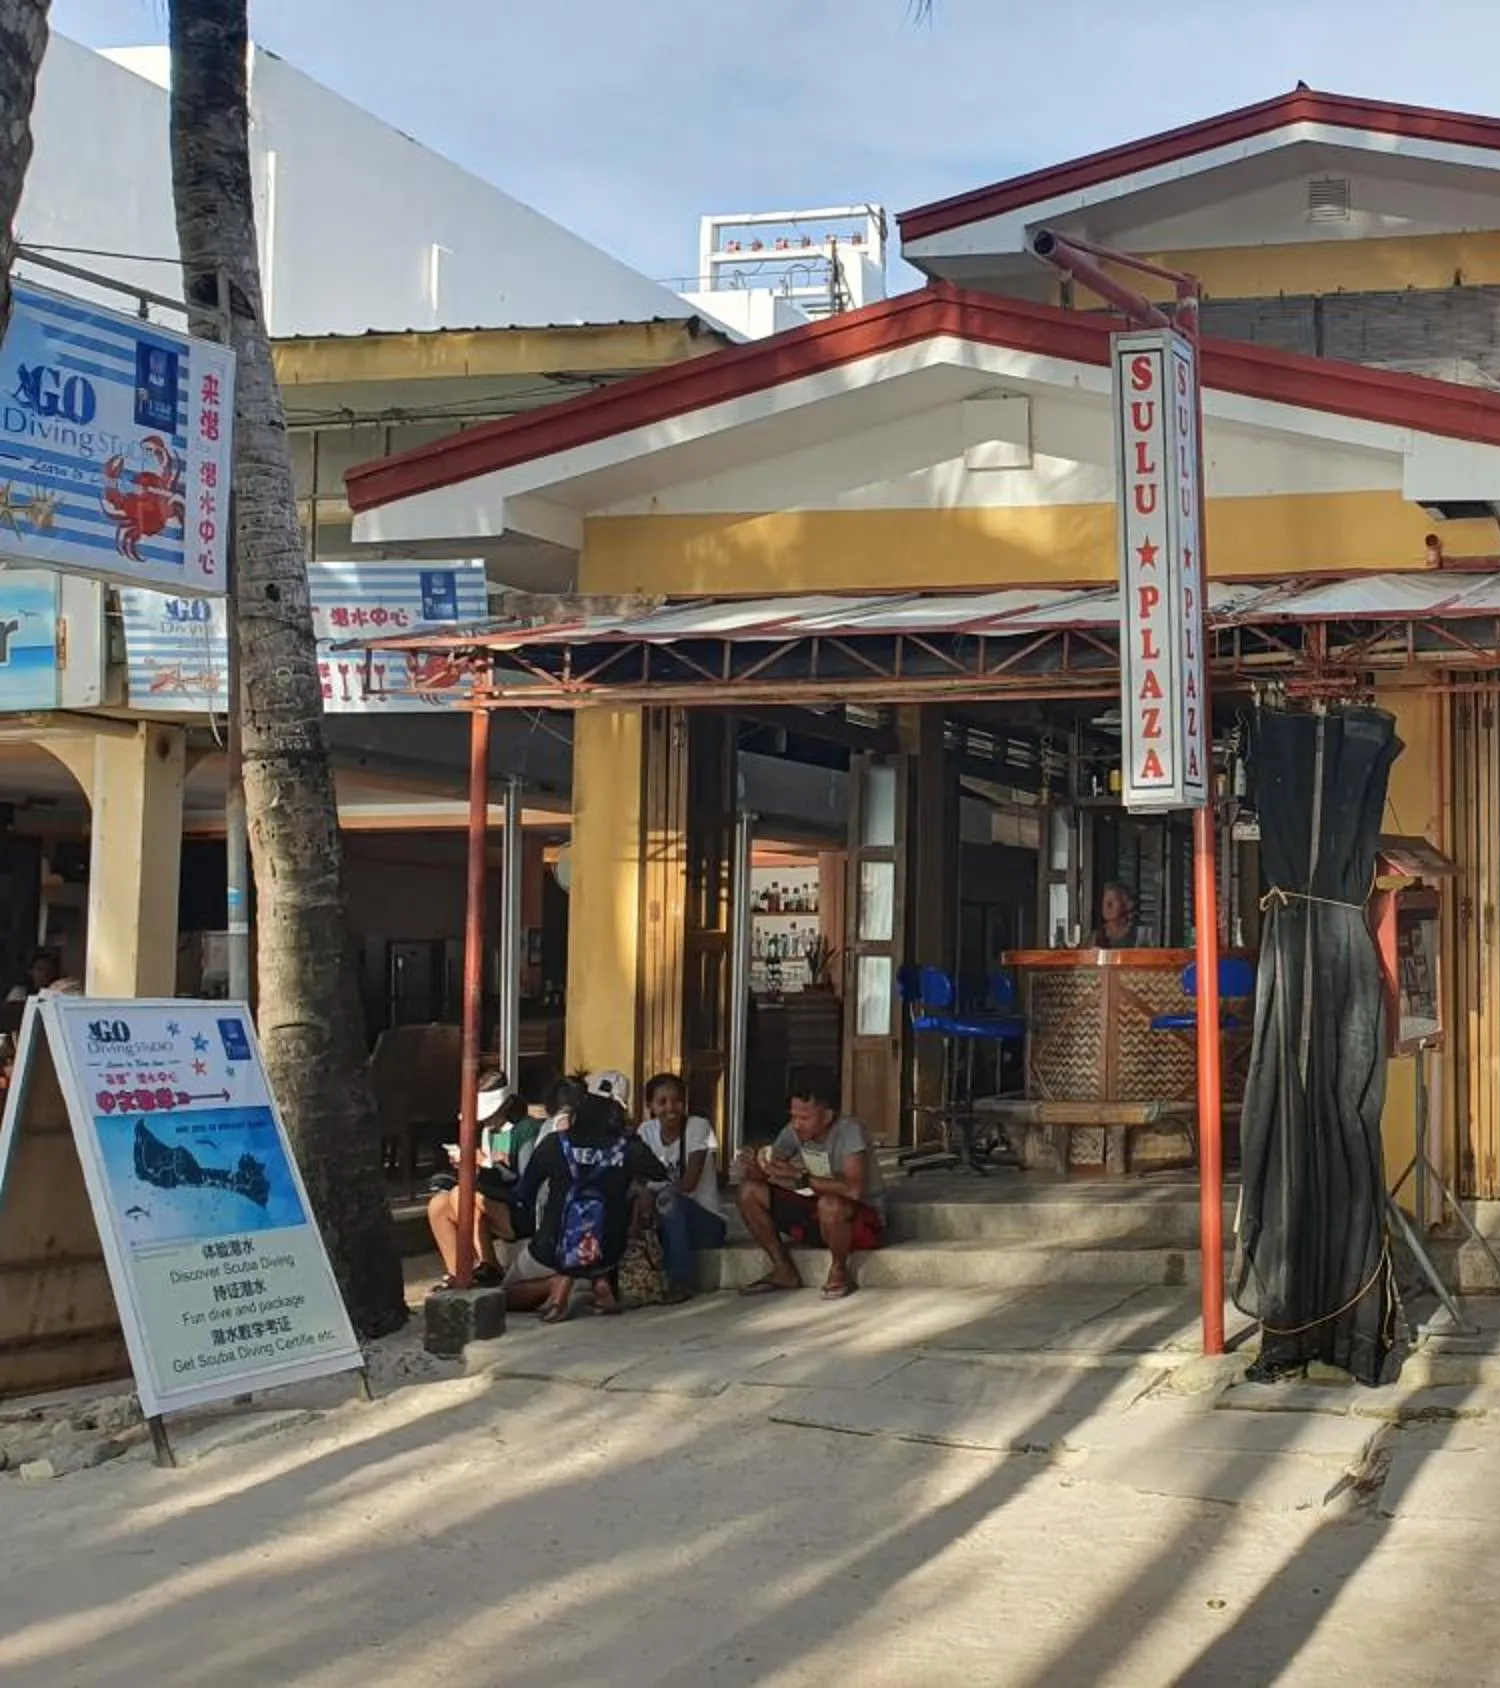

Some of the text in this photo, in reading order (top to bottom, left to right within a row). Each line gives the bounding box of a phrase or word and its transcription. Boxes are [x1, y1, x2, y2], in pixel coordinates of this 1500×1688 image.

[4, 406, 95, 458] Diving
[1131, 356, 1157, 514] SULU
[1177, 362, 1191, 518] SULU
[1137, 585, 1165, 778] PLAZA
[1184, 587, 1198, 777] PLAZA
[169, 1254, 295, 1284] Discover Scuba Diving
[181, 1294, 305, 1326] Fun dive and package
[173, 1358, 197, 1373] Get
[199, 1350, 237, 1368] Scuba
[238, 1342, 275, 1360] Diving
